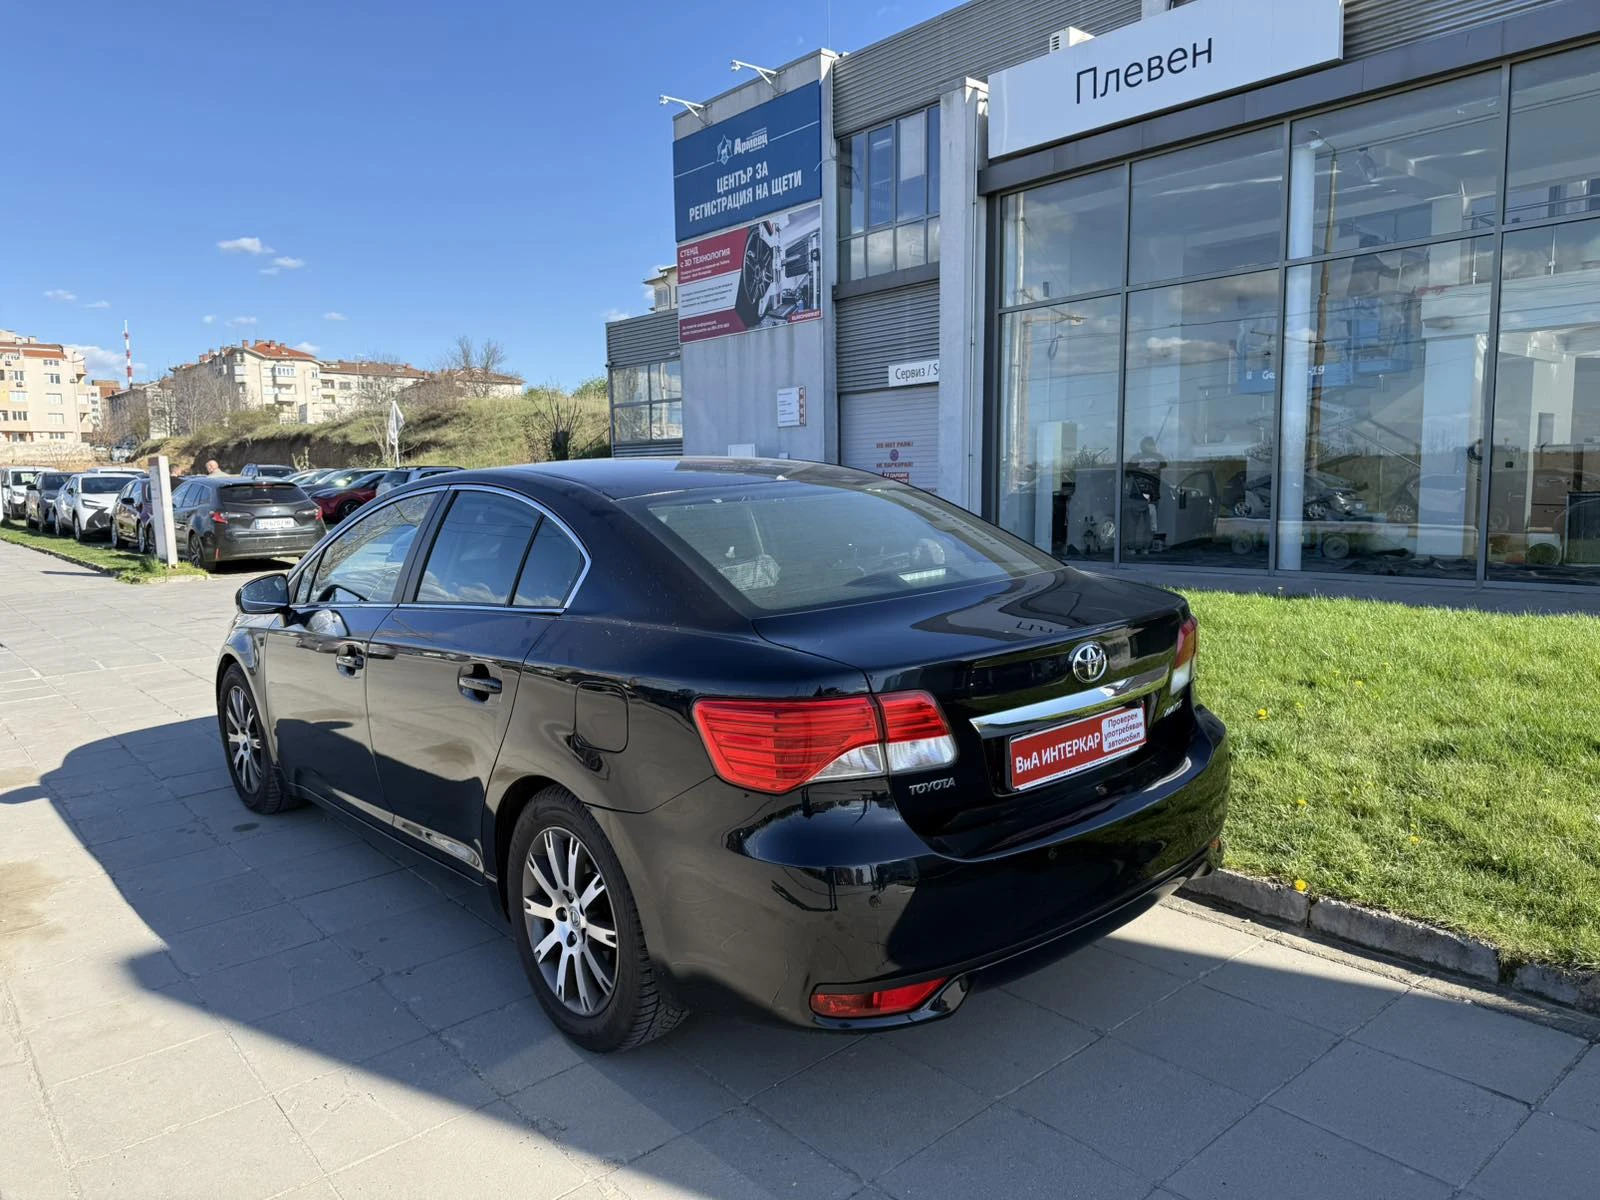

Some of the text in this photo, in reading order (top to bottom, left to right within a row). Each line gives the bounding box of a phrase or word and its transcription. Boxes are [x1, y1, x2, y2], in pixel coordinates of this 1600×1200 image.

[1076, 37, 1212, 104] Плевен
[716, 160, 769, 194] ЦЕНТЪР ЗА
[689, 169, 802, 222] РЕГИСТРАЦИЯ НА ЩЕТИ
[680, 246, 699, 258] СТЕНД
[693, 247, 731, 265] ТЕХНОЛОГИЯ
[895, 366, 925, 382] Сервиз
[933, 362, 939, 376] S
[1107, 712, 1139, 730] Проверен
[1103, 722, 1143, 742] употребяван
[1107, 731, 1141, 749] автомобил
[1015, 732, 1101, 774] ВиА ИНТЕРКАР
[909, 776, 956, 796] TOYOTA
